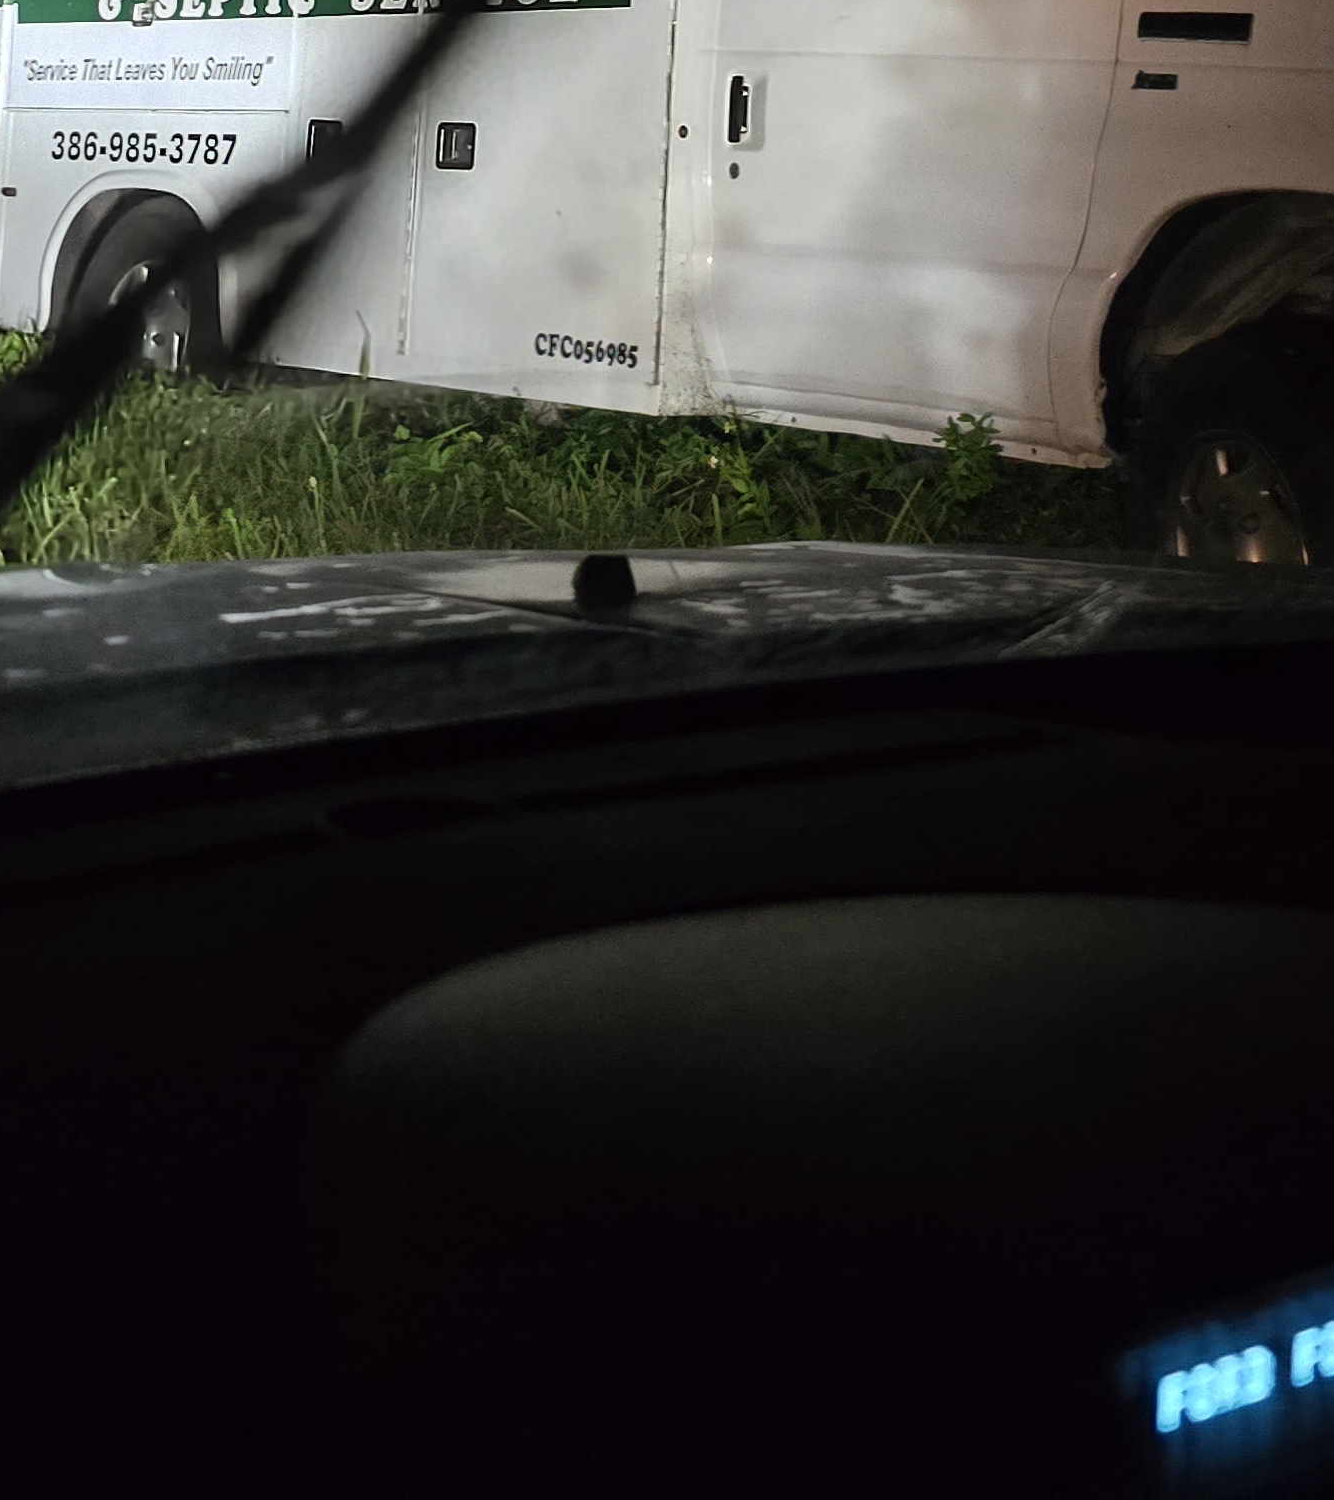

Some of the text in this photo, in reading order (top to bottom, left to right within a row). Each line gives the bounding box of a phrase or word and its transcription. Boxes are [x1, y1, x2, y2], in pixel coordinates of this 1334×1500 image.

[81, 58, 113, 81] That
[116, 57, 166, 81] Leaves
[171, 56, 200, 81] You
[203, 55, 275, 87] Smiling"
[534, 332, 639, 369] CFC056985
